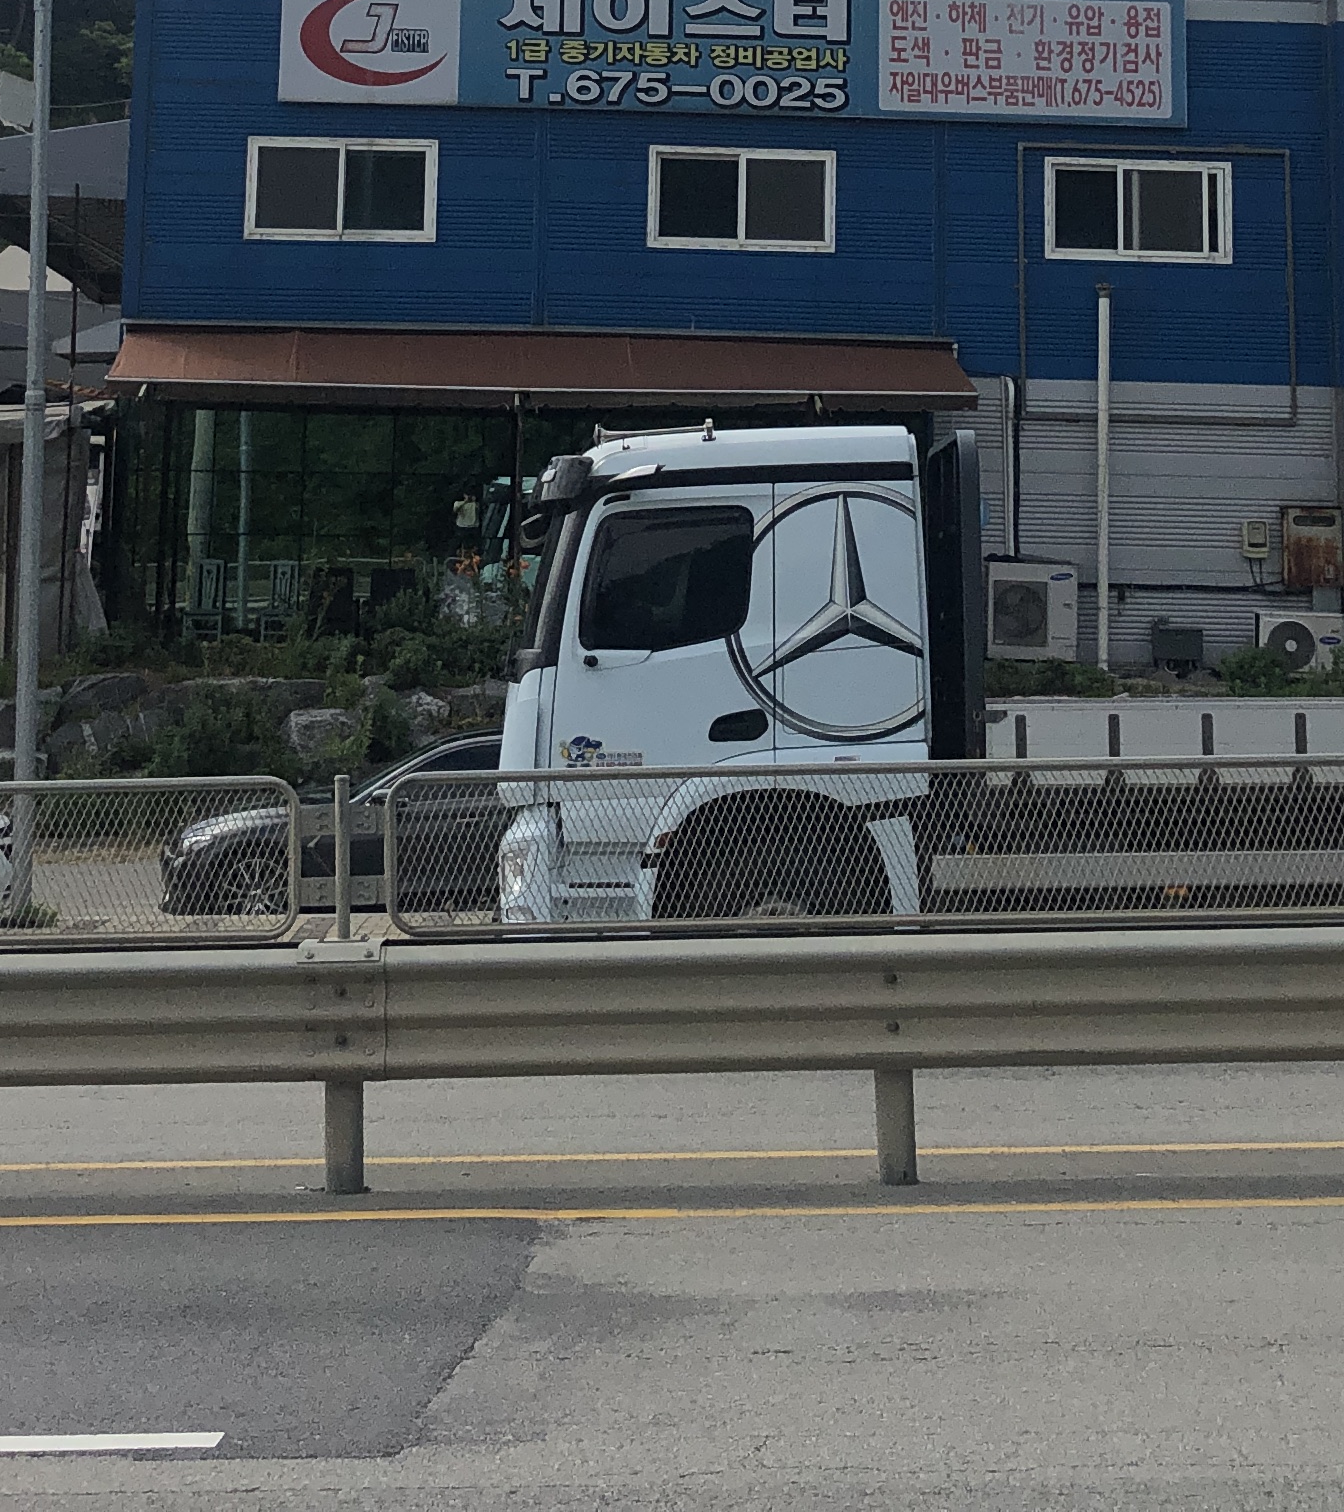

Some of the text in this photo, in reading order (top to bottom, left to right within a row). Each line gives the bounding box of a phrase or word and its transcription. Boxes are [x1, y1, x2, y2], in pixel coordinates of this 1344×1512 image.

[889, 0, 1161, 39] 엔진 하체 전기 유압 용접
[506, 39, 848, 71] 1급 중기자동차 정비공업사
[888, 35, 1162, 74] 도색 판금 환경정기검사
[506, 68, 847, 110] T.675-0025
